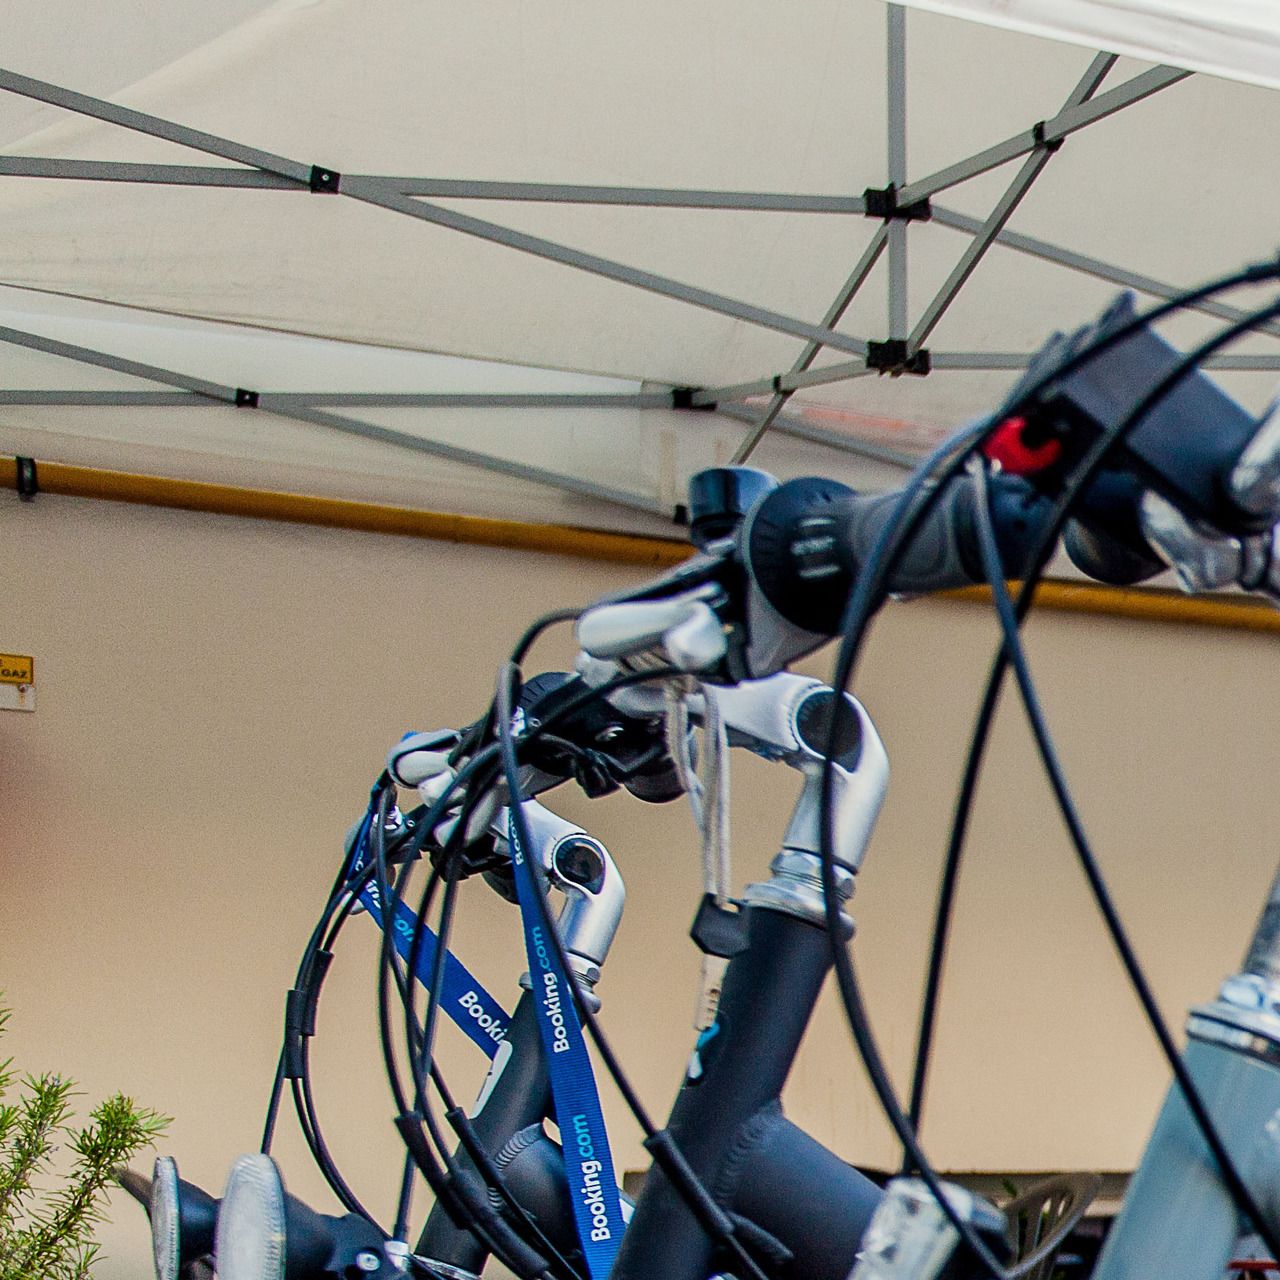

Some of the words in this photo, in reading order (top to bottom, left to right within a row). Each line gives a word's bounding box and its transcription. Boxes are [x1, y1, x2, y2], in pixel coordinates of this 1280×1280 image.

[458, 990, 508, 1044] Booki
[531, 926, 570, 1053] Booking.com
[572, 1114, 611, 1241] Booking.com
